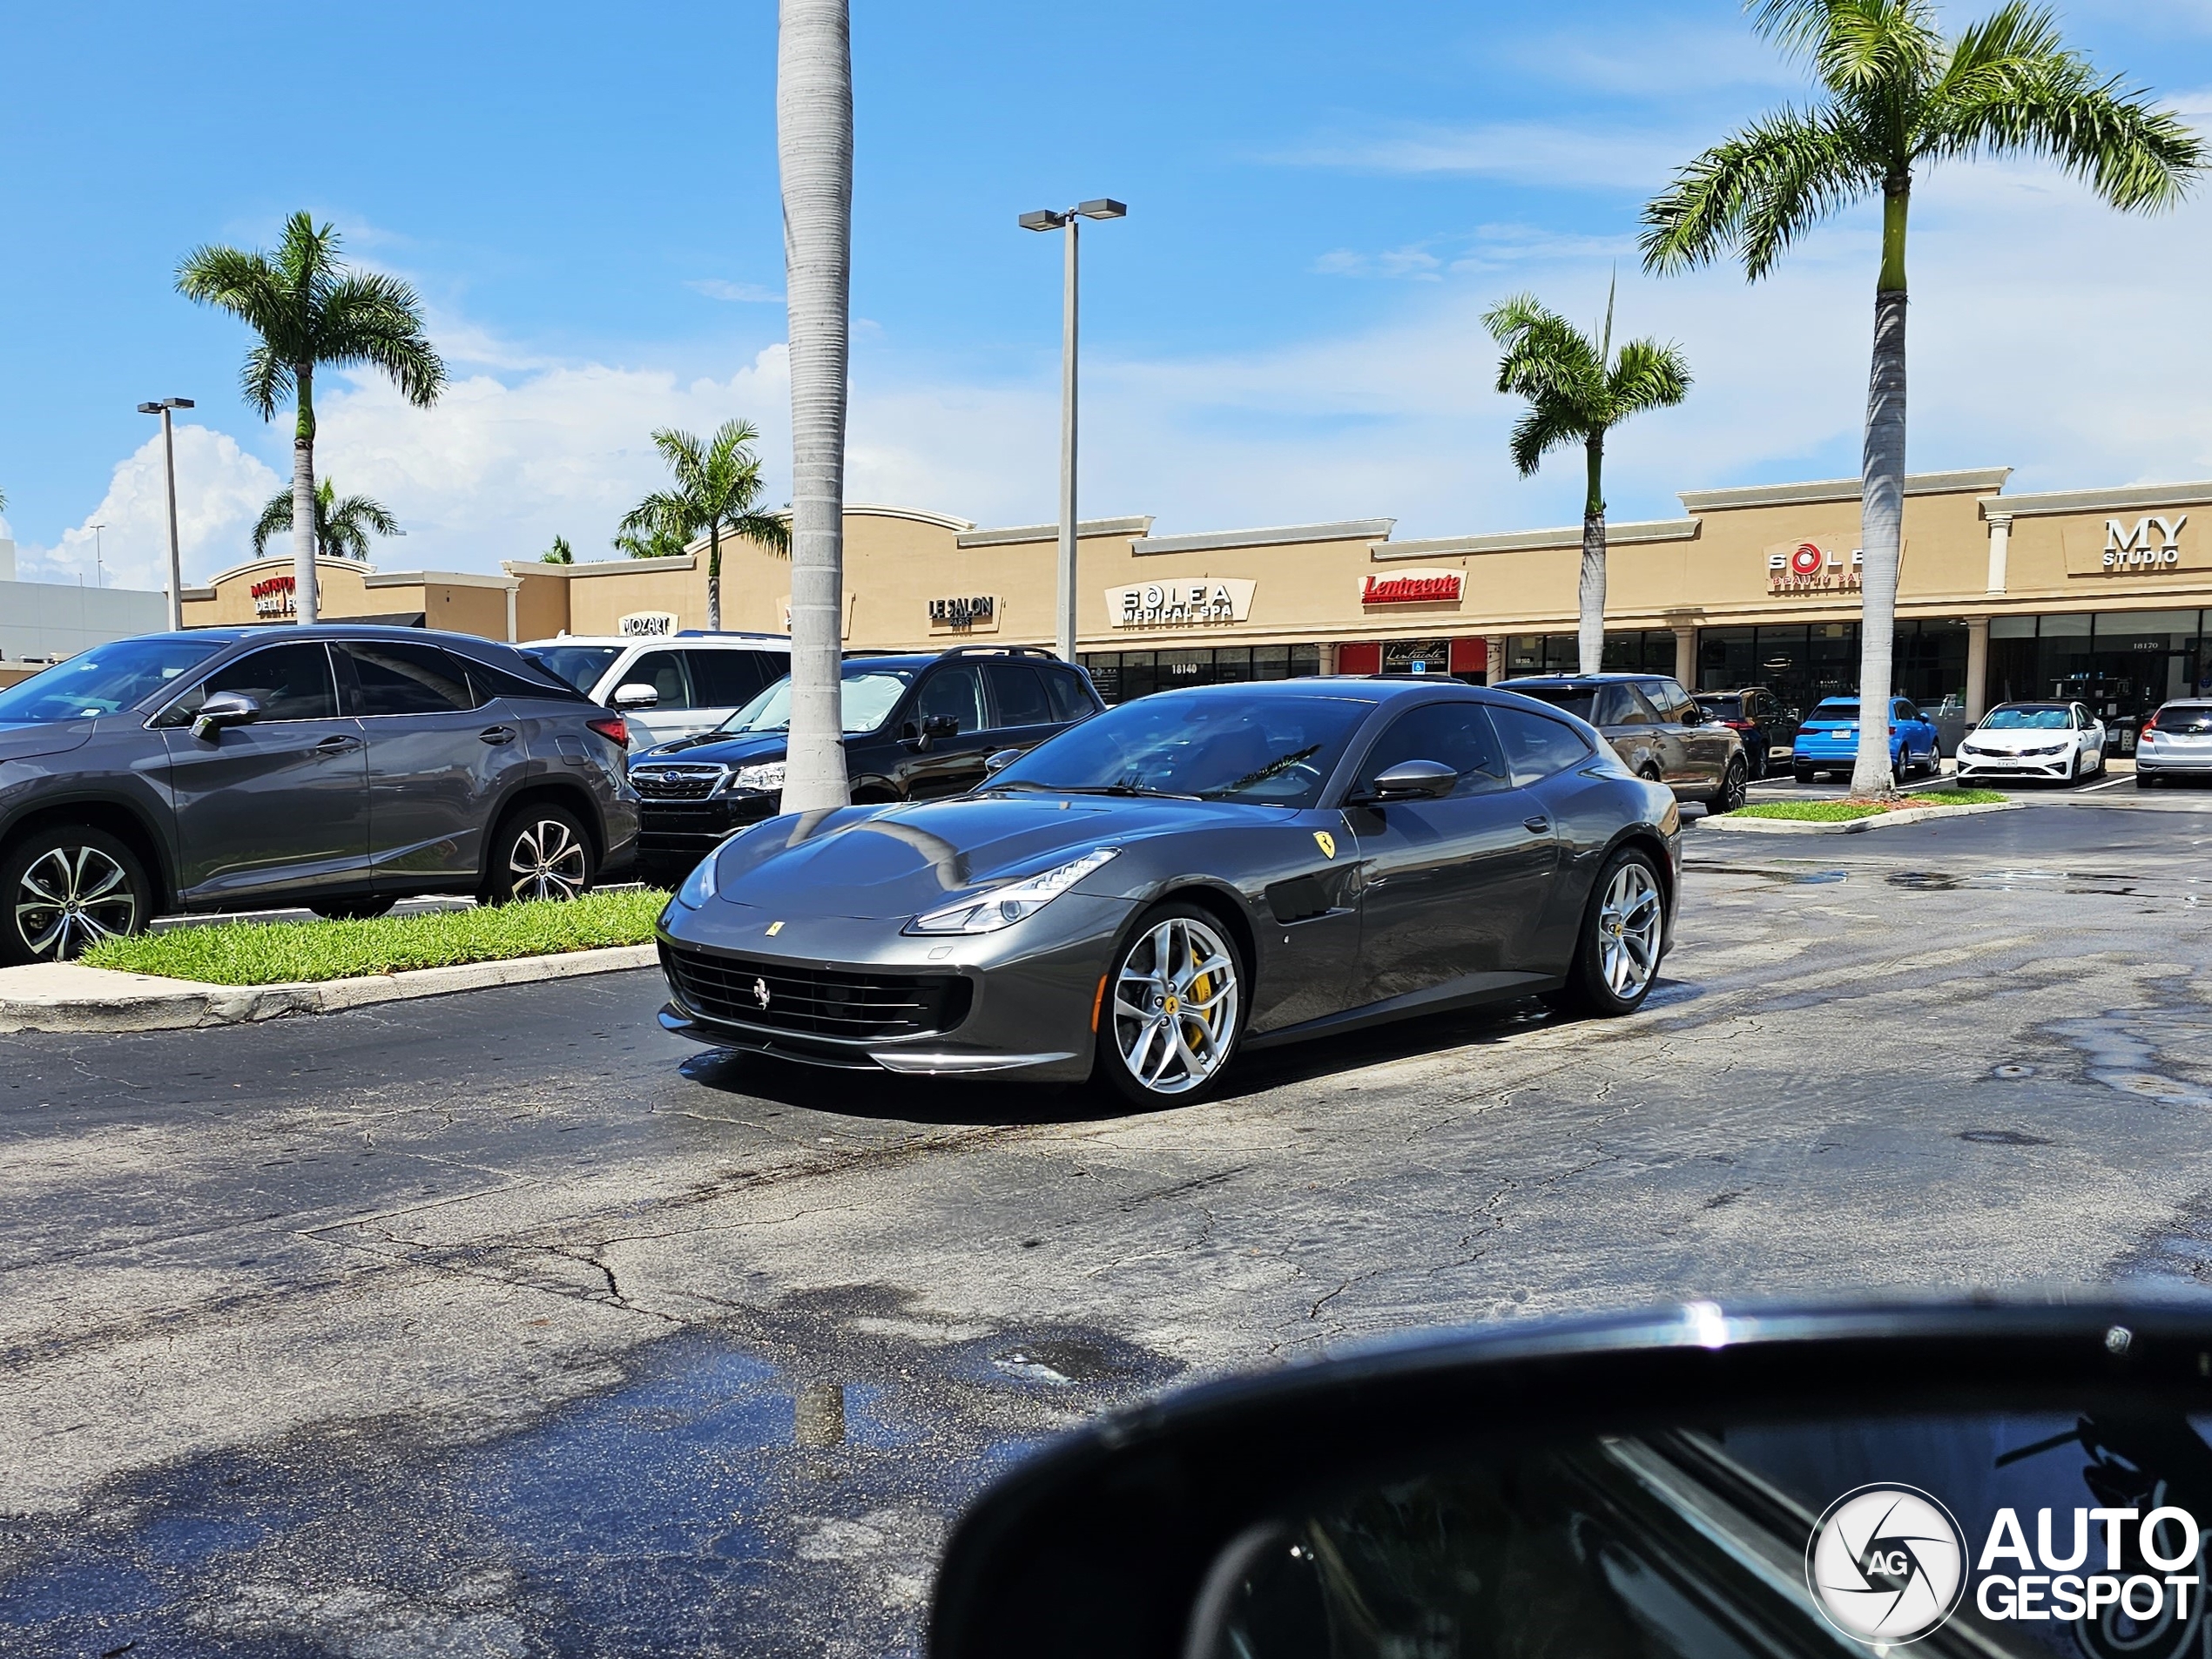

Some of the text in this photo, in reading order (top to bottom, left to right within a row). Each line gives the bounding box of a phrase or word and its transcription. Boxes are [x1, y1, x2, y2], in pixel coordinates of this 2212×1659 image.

[2103, 515, 2188, 550] MY
[1769, 543, 1863, 575] SOLE
[2102, 550, 2178, 566] STUDIO
[1364, 575, 1460, 595] Lentrecote
[1772, 573, 1863, 585] BEAUTY SAL
[1123, 584, 1232, 608] SOLEA
[929, 597, 993, 618] LE SALON
[1122, 604, 1232, 621] MEDICAL SPA
[623, 617, 669, 632] MOZART
[949, 617, 970, 626] PARIS
[1172, 664, 1197, 674] 18140
